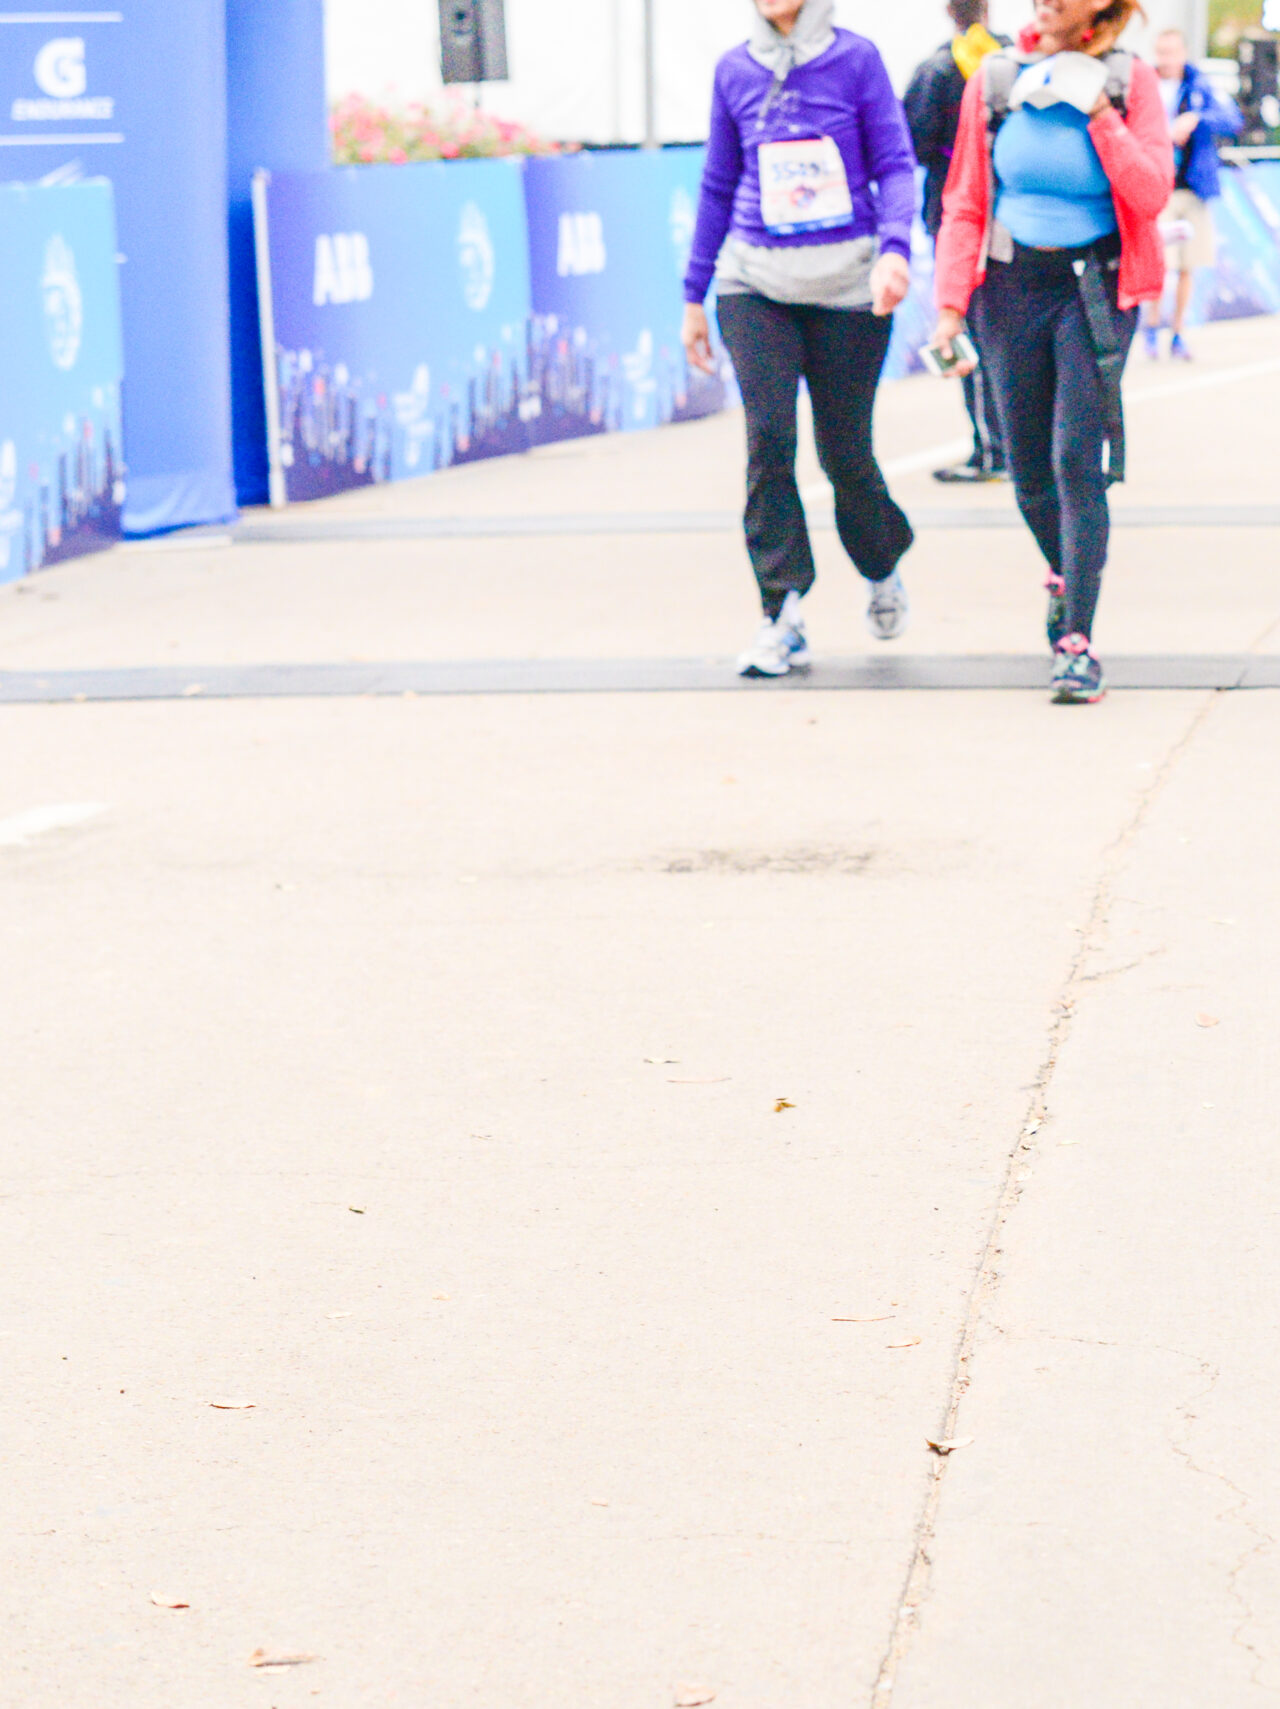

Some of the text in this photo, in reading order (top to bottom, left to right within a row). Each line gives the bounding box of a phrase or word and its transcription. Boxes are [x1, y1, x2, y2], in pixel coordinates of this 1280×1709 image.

[34, 37, 87, 98] G
[313, 231, 373, 306] ABB
[556, 211, 606, 277] ABB
